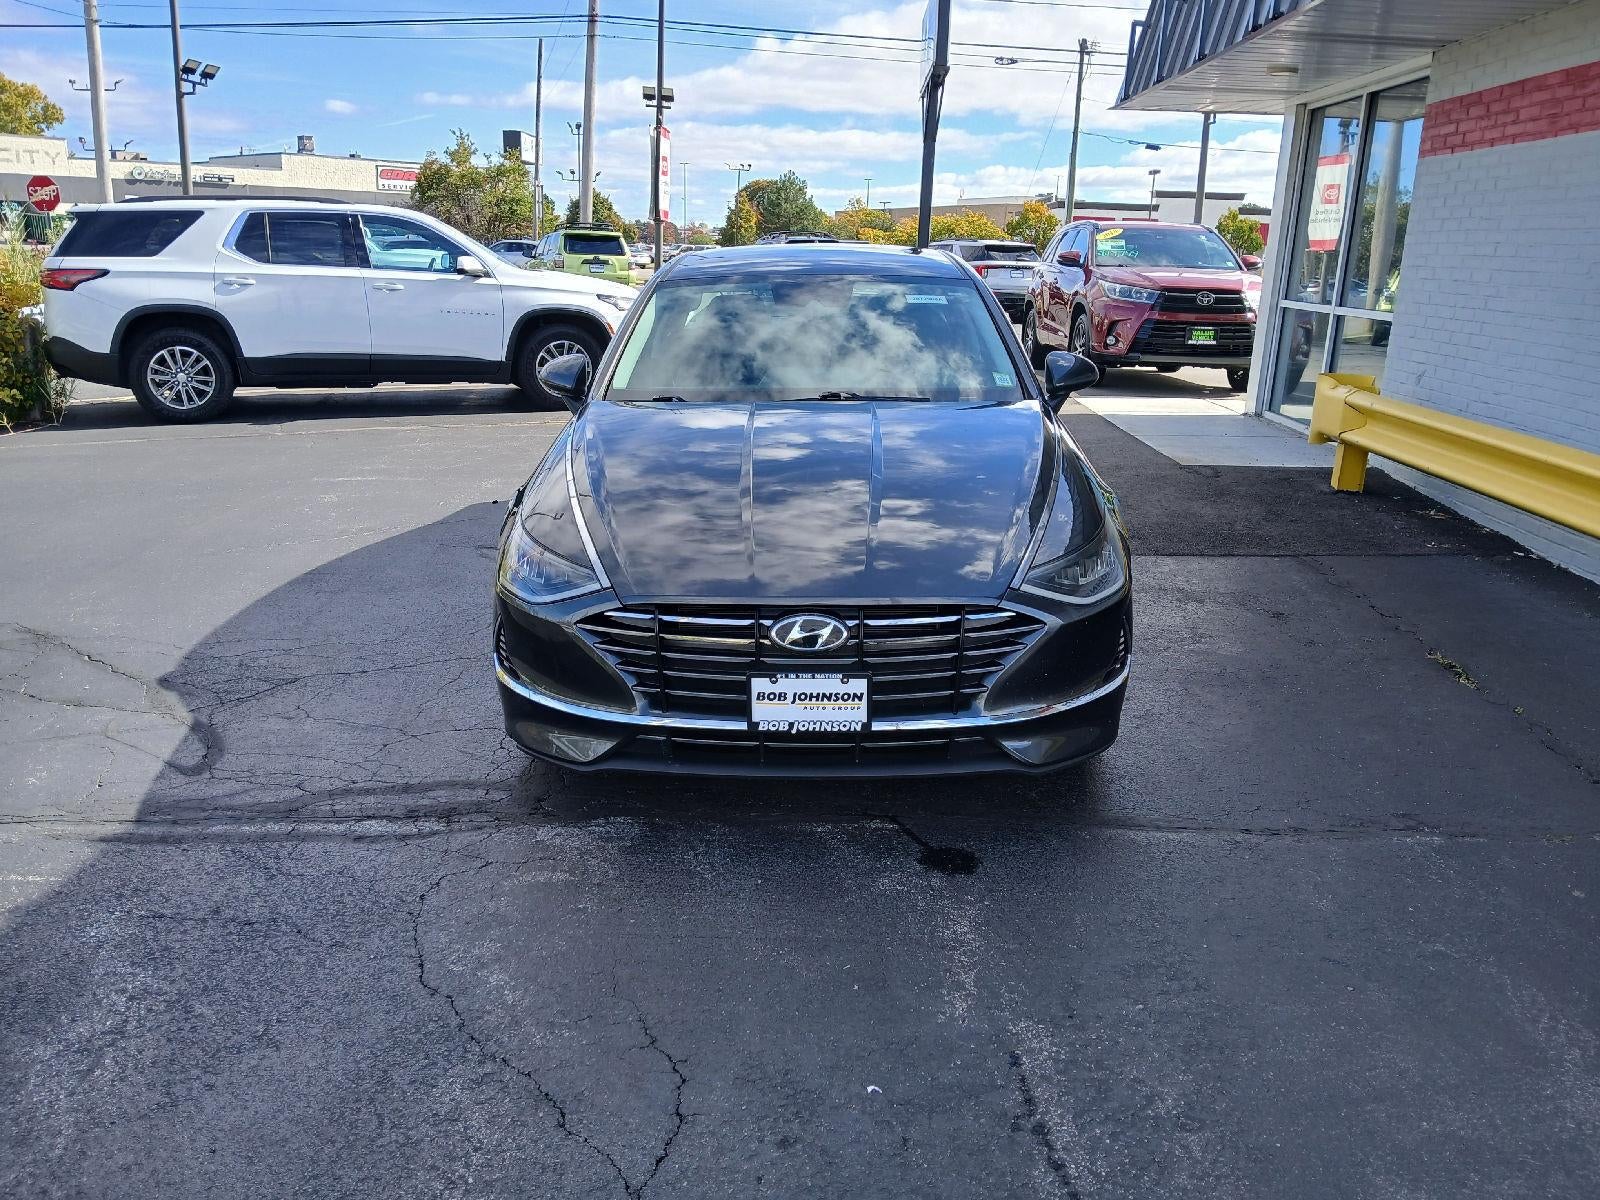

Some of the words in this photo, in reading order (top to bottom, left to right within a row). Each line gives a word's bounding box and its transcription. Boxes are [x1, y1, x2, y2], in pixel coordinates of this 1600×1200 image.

[28, 184, 59, 201] STOP
[756, 691, 788, 702] BOB
[790, 691, 865, 705] JOHNSON
[758, 720, 790, 731] BOB
[791, 720, 863, 734] JOHNSON
